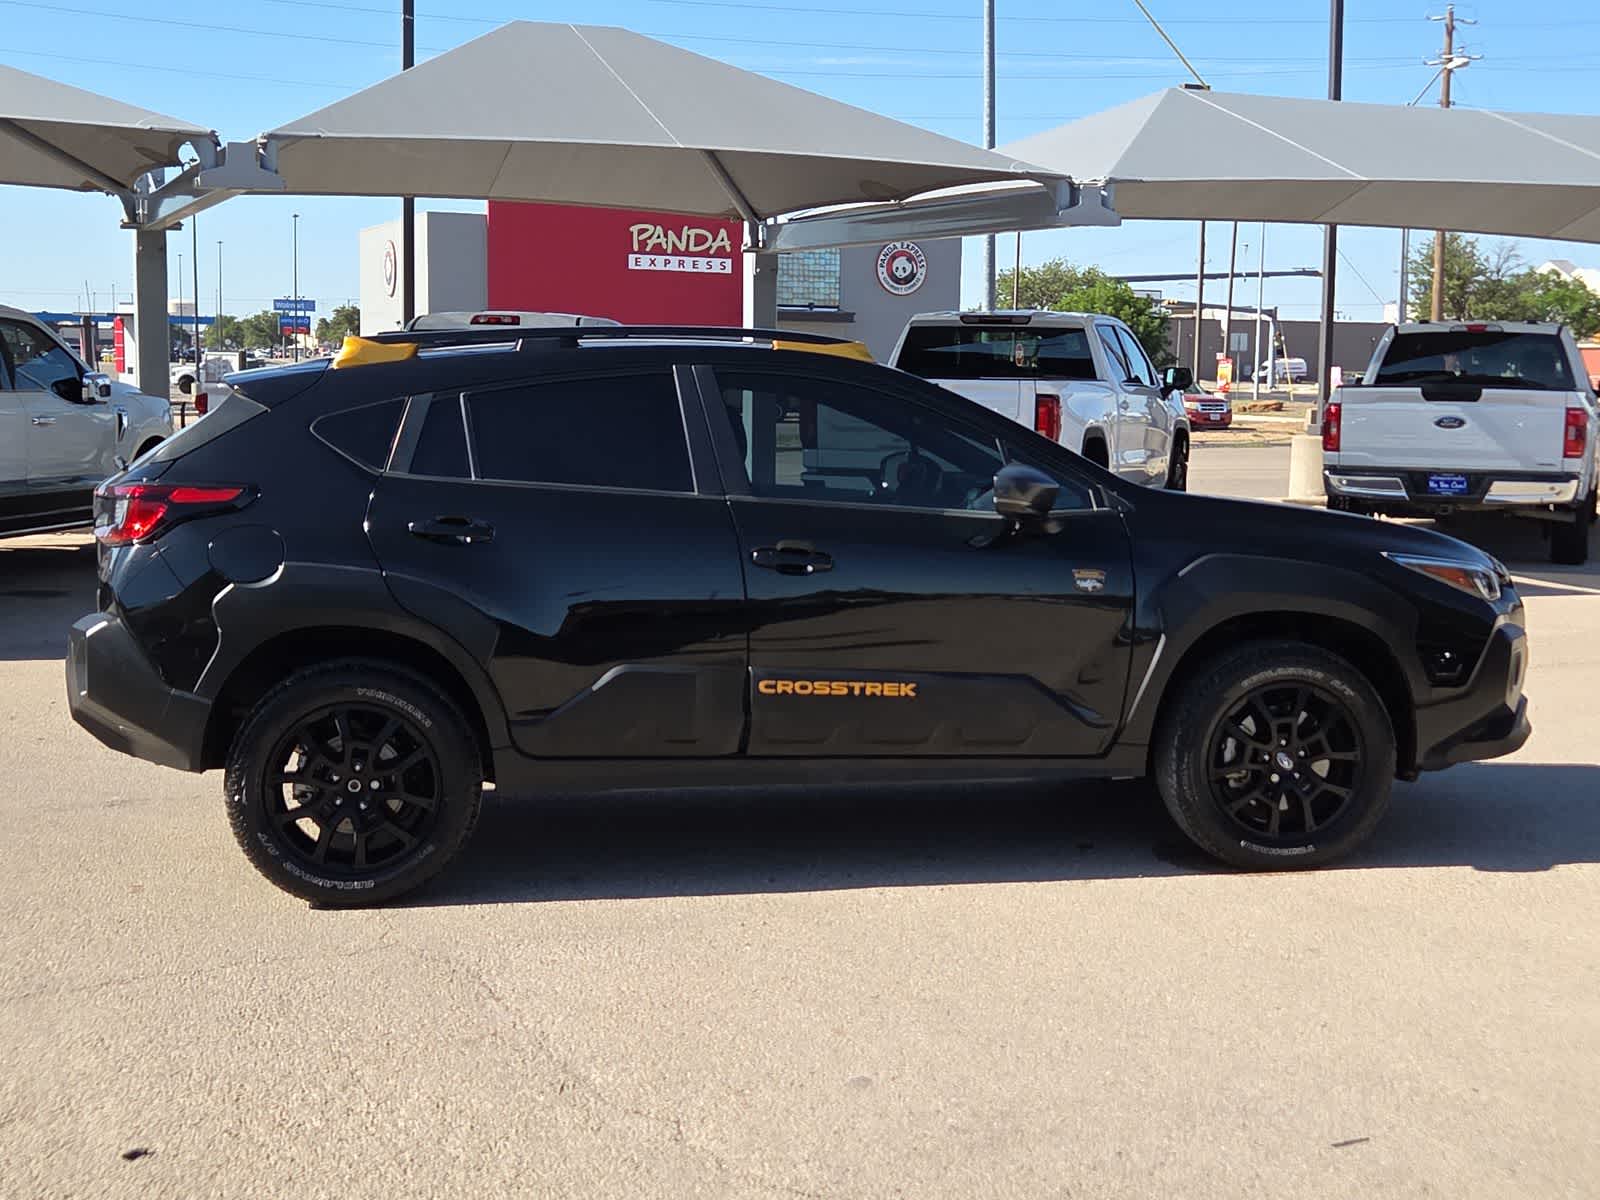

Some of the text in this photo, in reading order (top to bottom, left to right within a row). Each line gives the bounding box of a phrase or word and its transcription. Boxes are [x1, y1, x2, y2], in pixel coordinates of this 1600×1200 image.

[629, 223, 731, 255] PANDA
[634, 257, 727, 271] EXPRESS
[880, 242, 925, 268] PANDA EXPRESS
[758, 680, 917, 697] CROSSTREK
